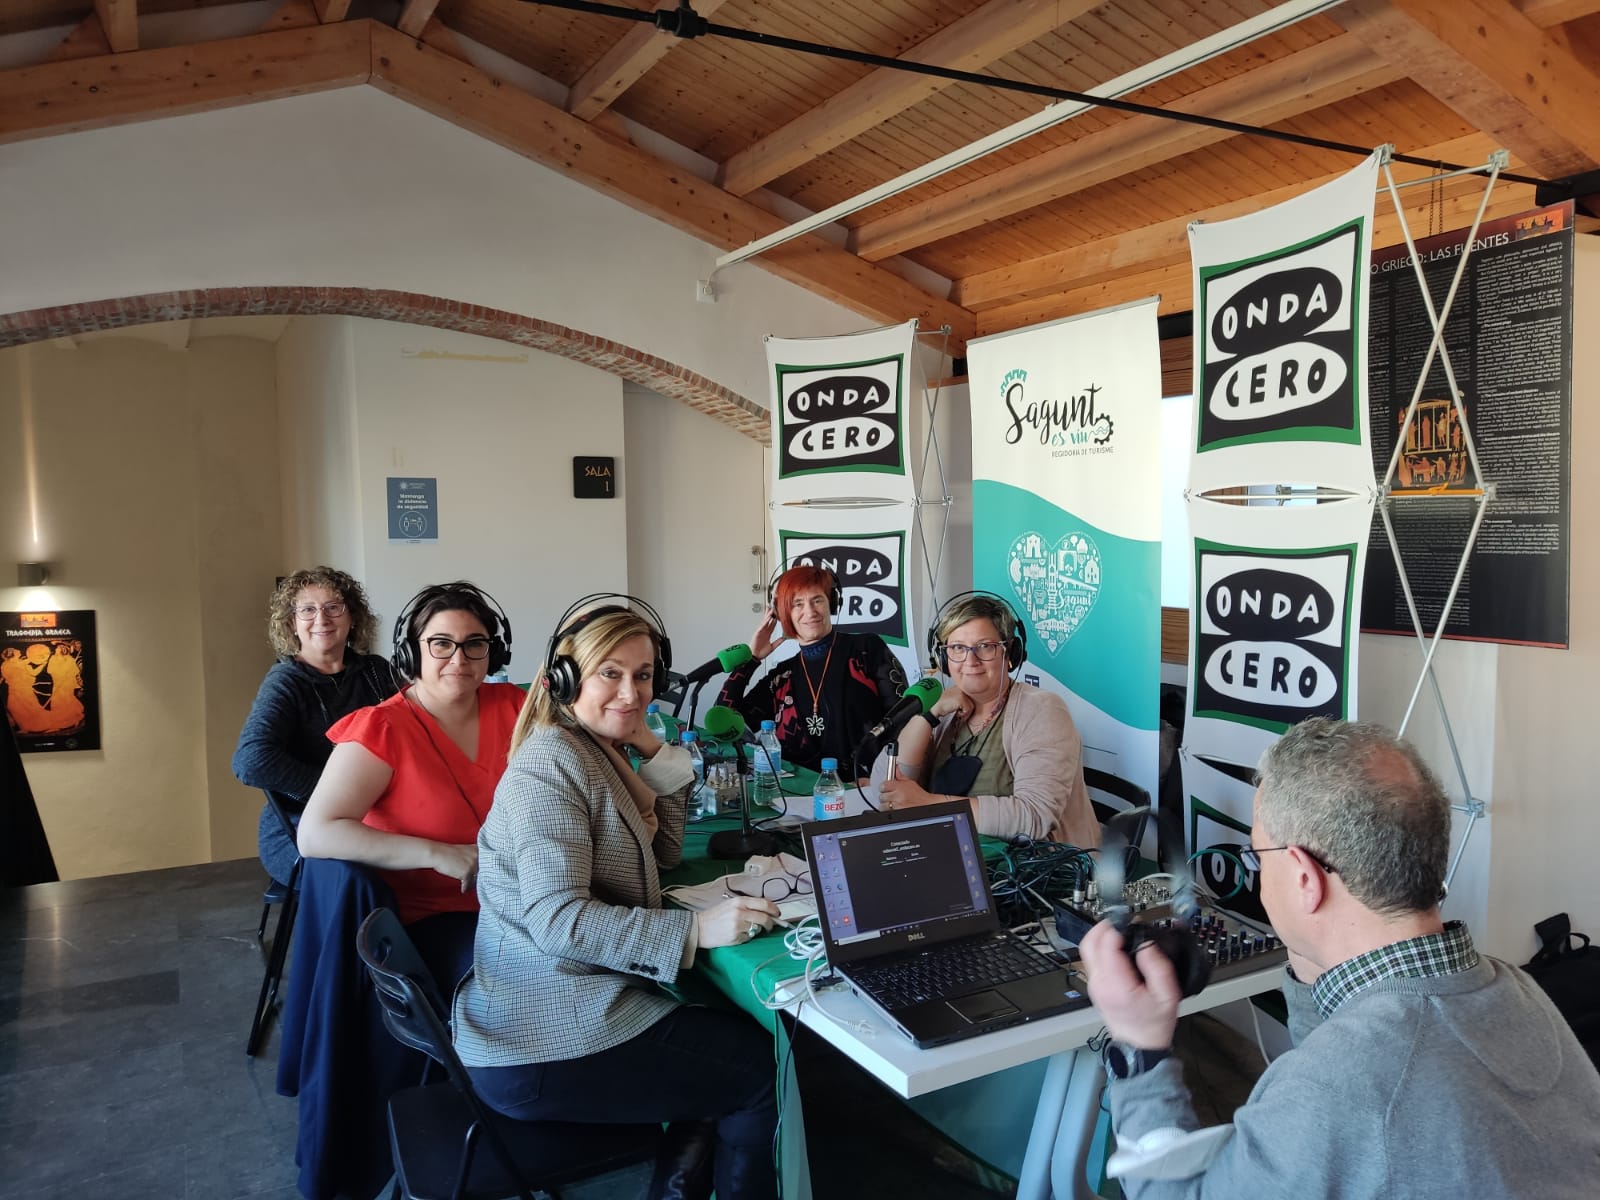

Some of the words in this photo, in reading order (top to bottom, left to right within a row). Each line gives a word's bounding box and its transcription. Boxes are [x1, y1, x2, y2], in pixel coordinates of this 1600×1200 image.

[1430, 246, 1452, 261] LAS
[1222, 282, 1328, 340] ONDA
[796, 385, 880, 412] ONDA
[1225, 357, 1328, 408] CERO
[1005, 382, 1103, 445] Sagunt
[801, 426, 881, 452] CERO
[584, 465, 612, 477] SALA
[1216, 585, 1320, 625] ONDA
[1220, 649, 1318, 698] CERO
